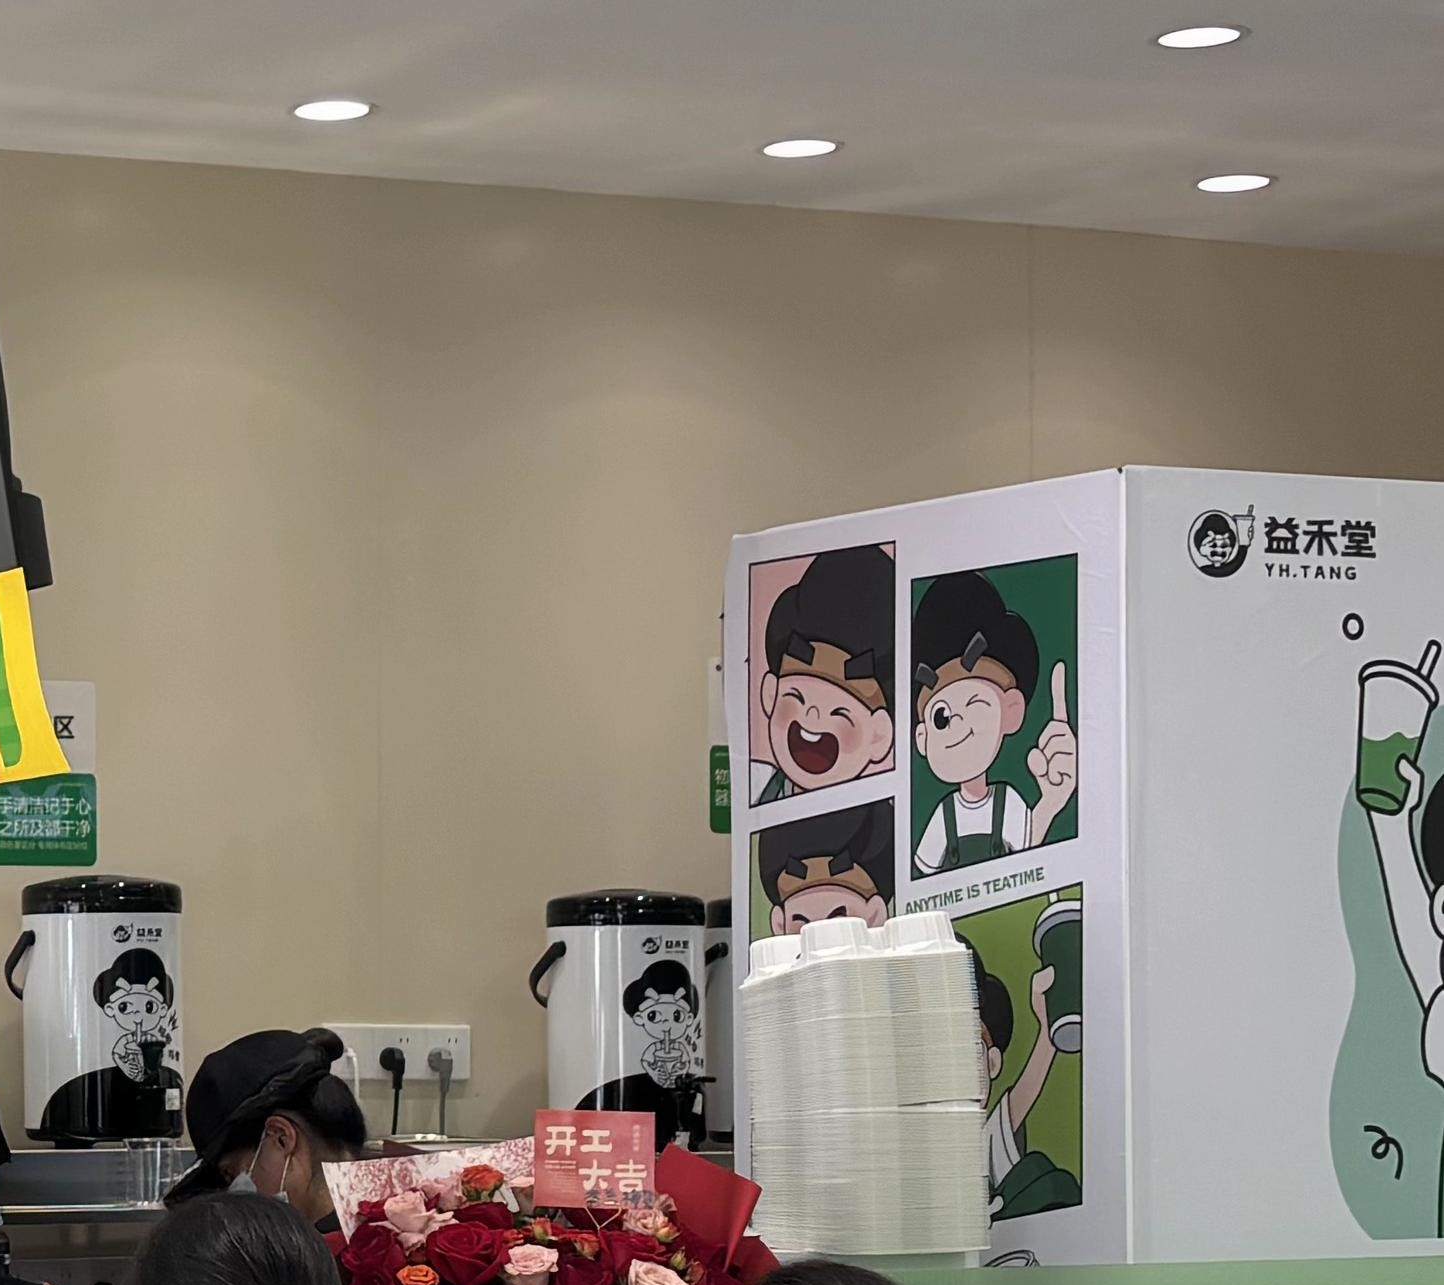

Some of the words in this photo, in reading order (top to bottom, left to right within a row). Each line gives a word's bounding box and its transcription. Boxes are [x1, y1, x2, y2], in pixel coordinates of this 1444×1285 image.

[1263, 516, 1377, 558] 益禾堂
[1264, 563, 1358, 581] YH.TANG
[905, 889, 964, 914] ANYTIME
[967, 884, 981, 900] IS
[983, 867, 1046, 895] TEATIME
[544, 1125, 613, 1156] 开工
[578, 1158, 648, 1193] 大吉
